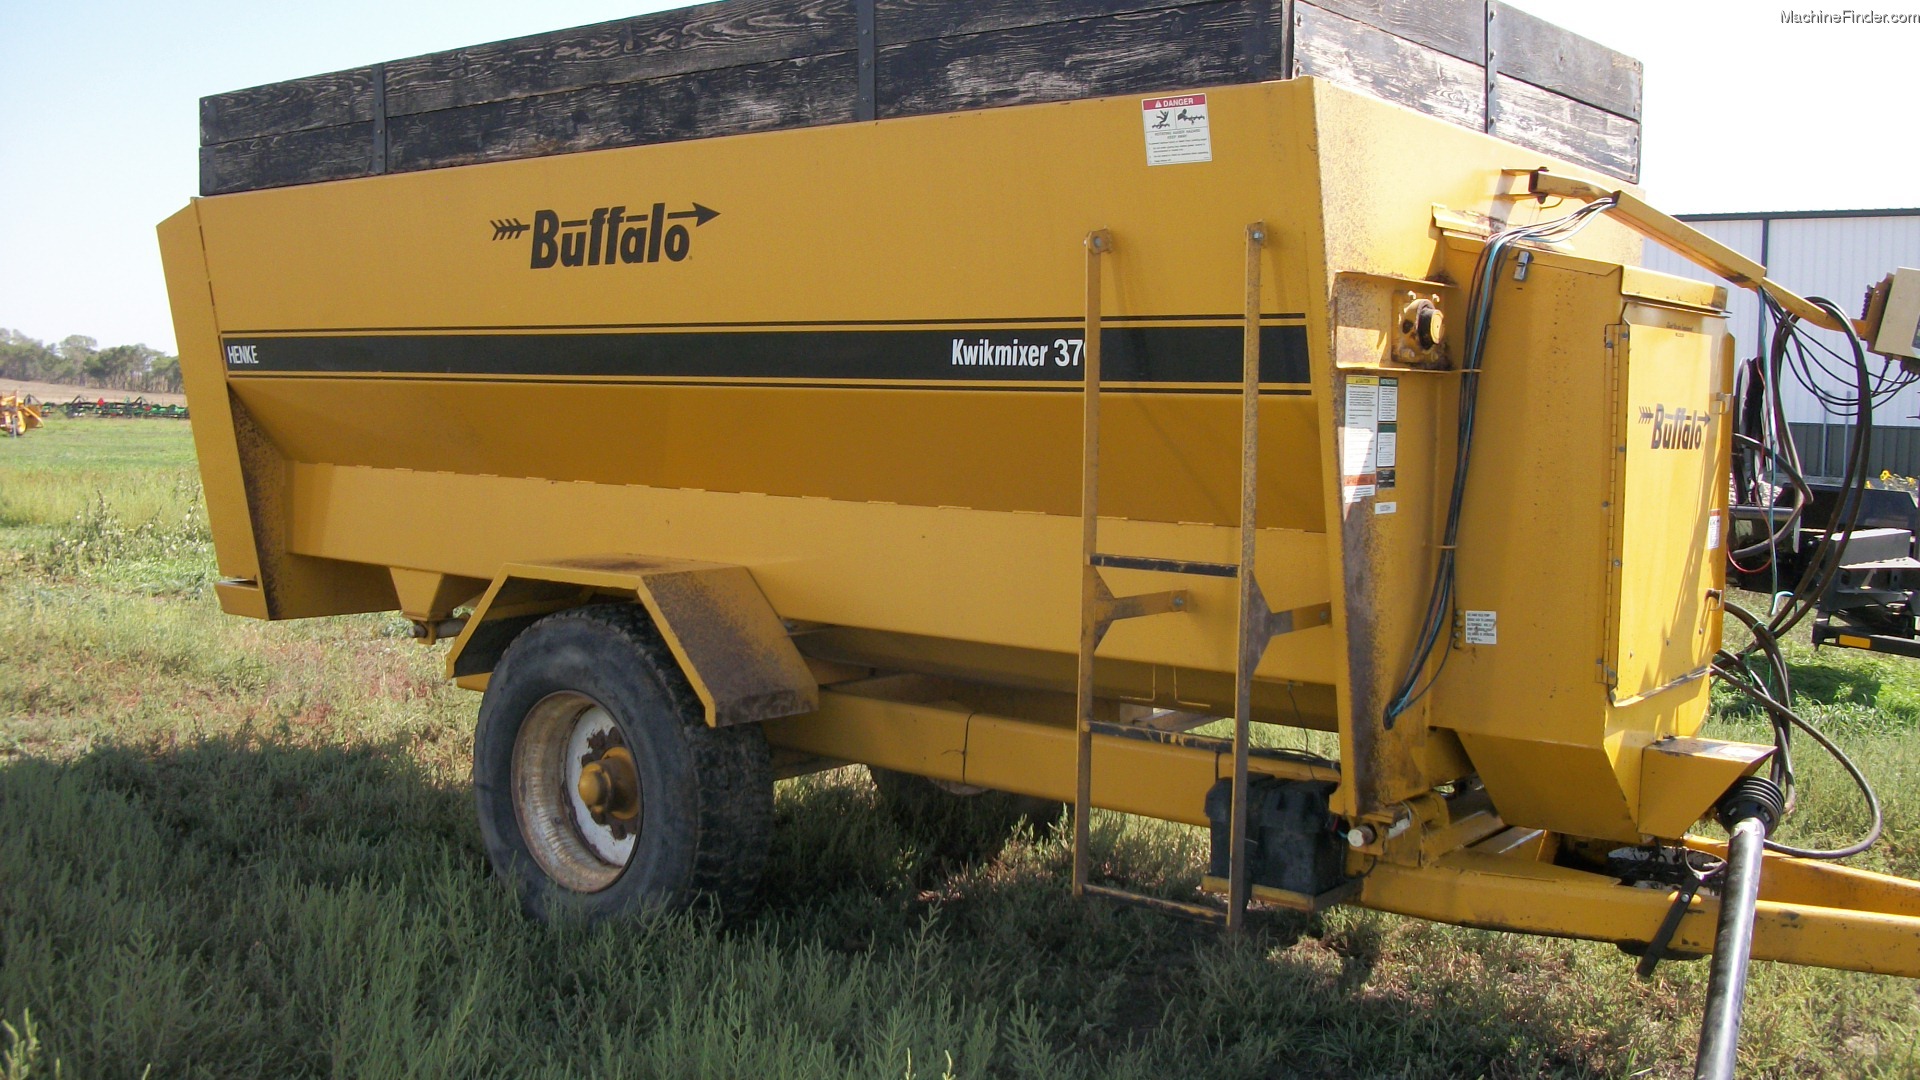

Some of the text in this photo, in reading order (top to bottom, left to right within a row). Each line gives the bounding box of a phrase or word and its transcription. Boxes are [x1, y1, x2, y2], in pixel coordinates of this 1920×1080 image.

[1163, 98, 1193, 107] DANGER
[530, 203, 690, 269] Buffalo
[227, 345, 259, 364] HENKE
[951, 338, 1048, 367] Kwikmixer
[1651, 403, 1702, 450] Buffalo
